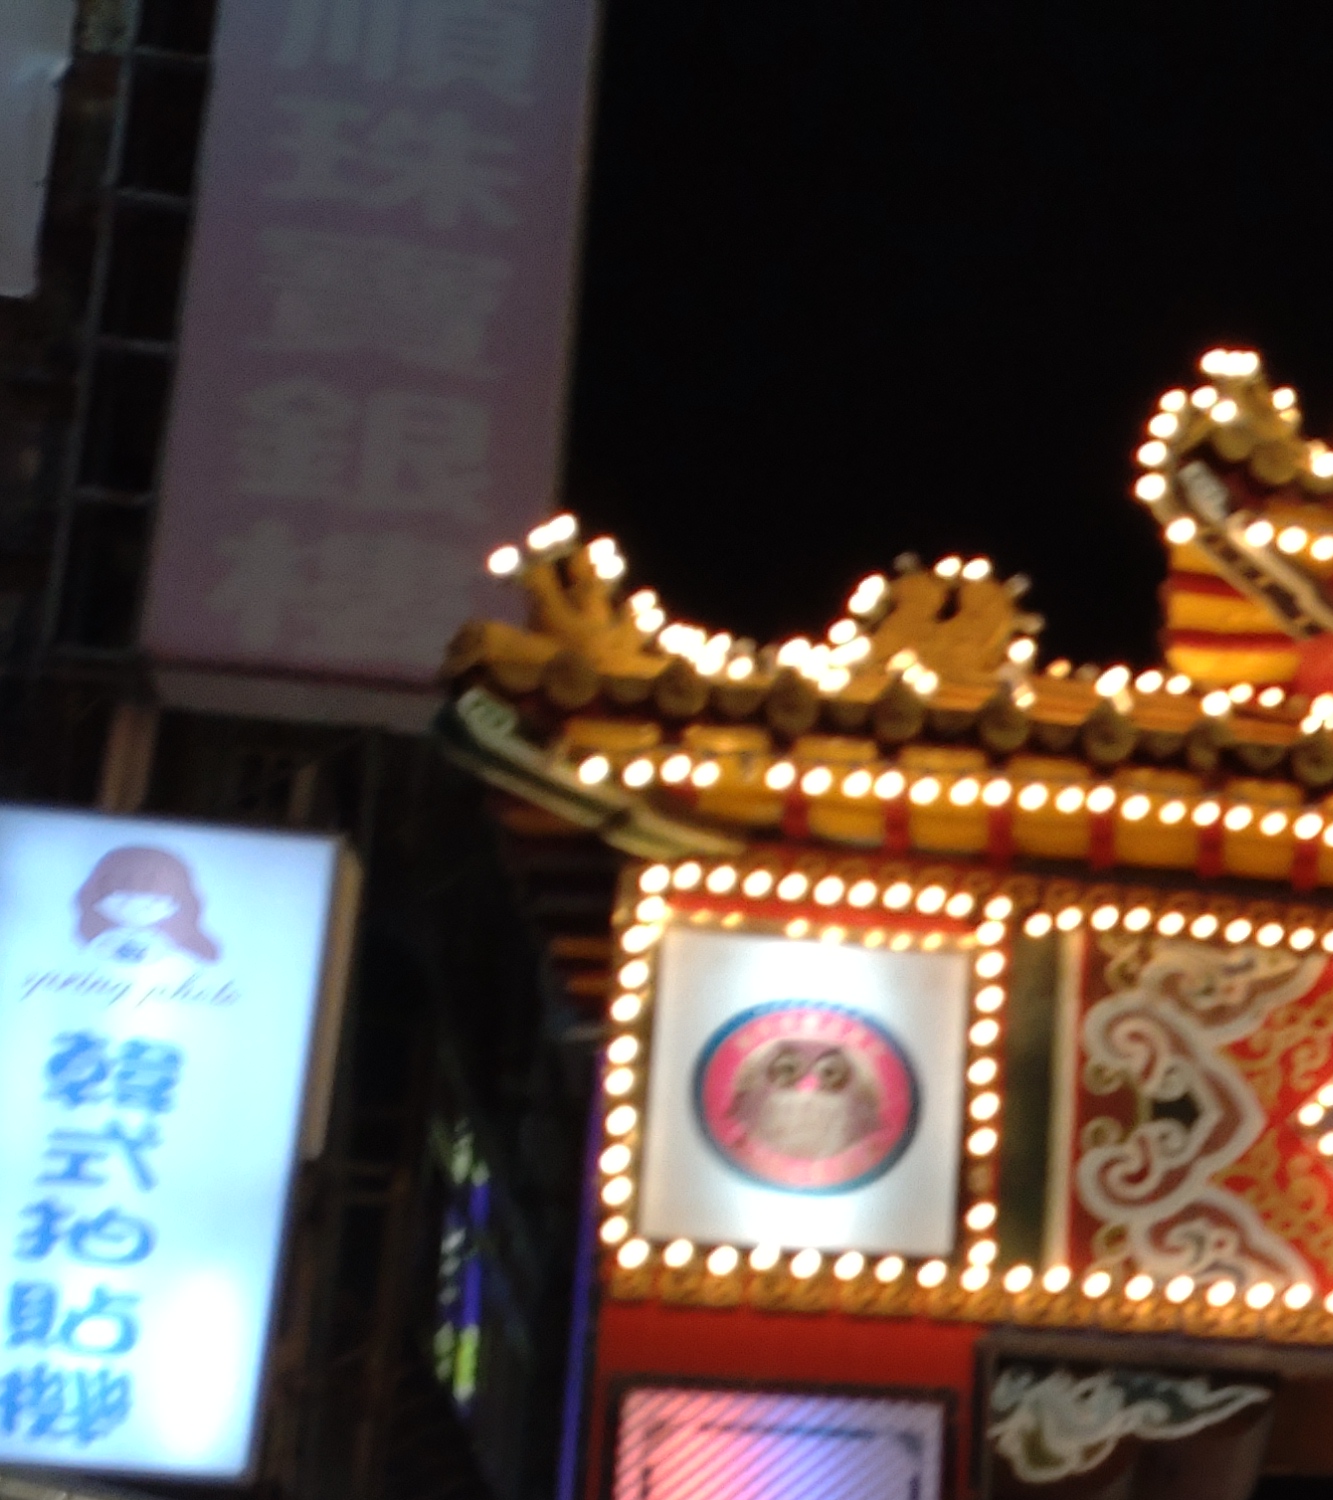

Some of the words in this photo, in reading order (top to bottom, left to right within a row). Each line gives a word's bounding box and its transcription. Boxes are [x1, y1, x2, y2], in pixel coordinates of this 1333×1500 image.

[0, 1031, 185, 1444] 韓式拍貼機
